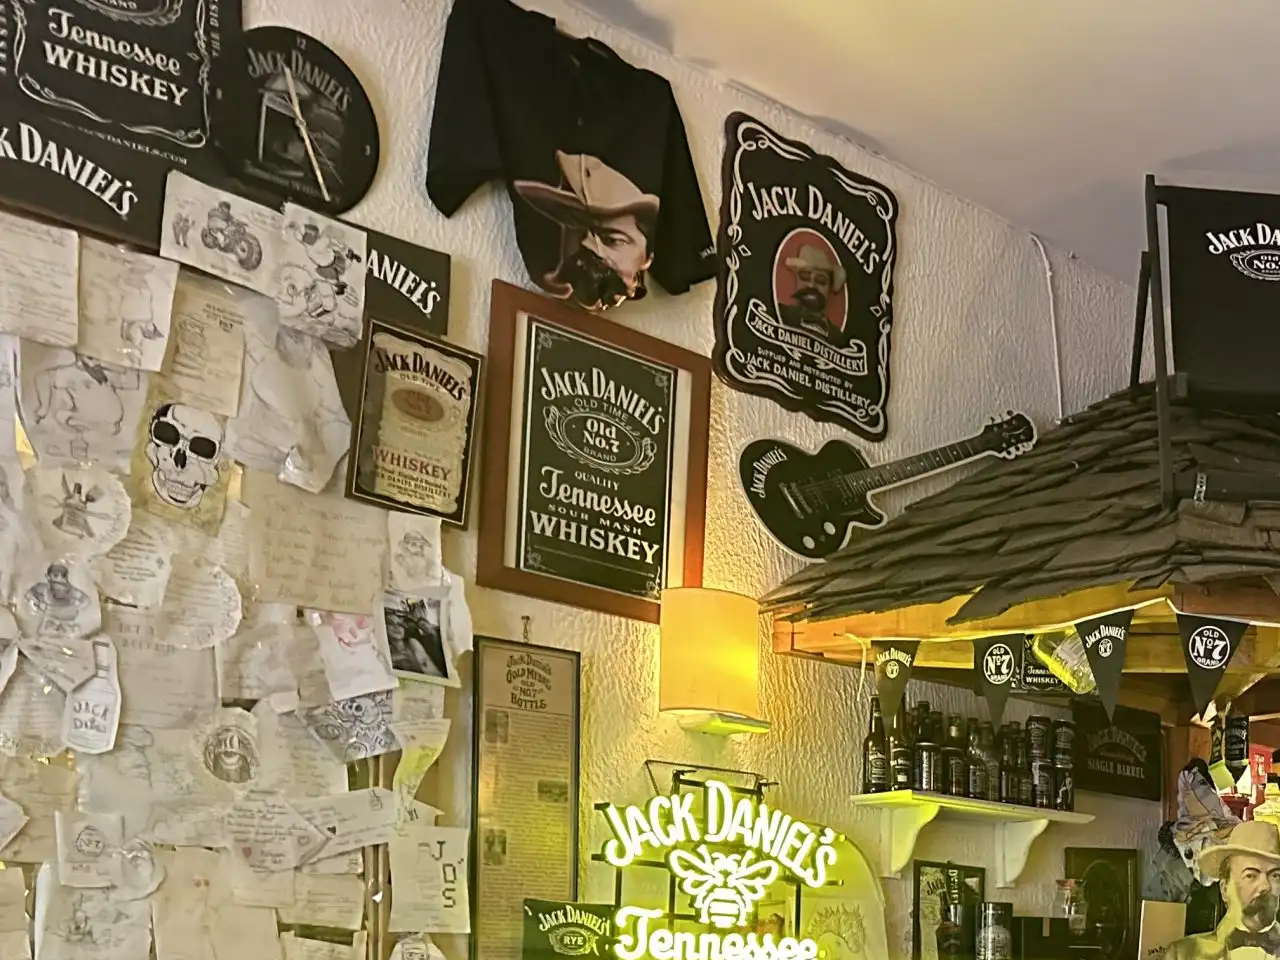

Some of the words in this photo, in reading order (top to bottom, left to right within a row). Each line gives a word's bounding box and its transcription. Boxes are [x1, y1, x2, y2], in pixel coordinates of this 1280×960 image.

[48, 8, 181, 76] Tennessee
[42, 40, 189, 106] WHISKEY
[247, 47, 287, 78] JACK
[291, 49, 352, 112] DANIEL'S
[19, 121, 139, 220] DANIEL'S
[747, 182, 804, 221] JACK
[808, 184, 880, 275] DANIEL'S
[1205, 228, 1256, 255] JACK
[366, 248, 441, 318] ANIEL'S
[750, 316, 775, 339] JACK
[778, 328, 812, 351] DANIEL
[813, 342, 865, 372] DISTILLERY
[757, 346, 786, 363] SUPPLIED
[375, 348, 411, 375] JACK
[412, 351, 467, 402] DANIEL'S
[745, 351, 770, 374] JACK
[773, 363, 812, 389] DANIEL
[814, 381, 871, 410] DISTILLERY
[540, 367, 590, 401] JACK
[592, 367, 666, 435] DANIEL'S
[574, 397, 598, 409] OLD
[602, 402, 629, 421] TIME
[582, 430, 620, 454] No.7
[585, 418, 617, 440] Old
[372, 445, 453, 481] WHISKEY
[583, 447, 617, 462] BRAND
[753, 446, 789, 475] DANIEL'S
[574, 470, 620, 491] QUALITY
[750, 470, 766, 498] JACK
[539, 465, 656, 527] Tennessee
[548, 503, 589, 522] SOUR
[599, 518, 642, 536] MASH
[530, 510, 660, 565] WHISKEY
[1085, 631, 1101, 649] JACK
[1100, 624, 1126, 641] DANIEL'S
[1203, 629, 1219, 638] OLD
[875, 650, 891, 666] JACK
[890, 647, 912, 668] DANIEL'S
[1196, 657, 1220, 667] BRAND
[506, 667, 526, 684] GOLD
[1026, 676, 1059, 685] WHISKEY
[511, 691, 547, 709] BOTTLE
[601, 791, 700, 867] JACK
[702, 779, 837, 890] DANIEL'S
[539, 908, 567, 932] JACK
[566, 904, 606, 936] DANIEL'S
[563, 935, 584, 946] RYE
